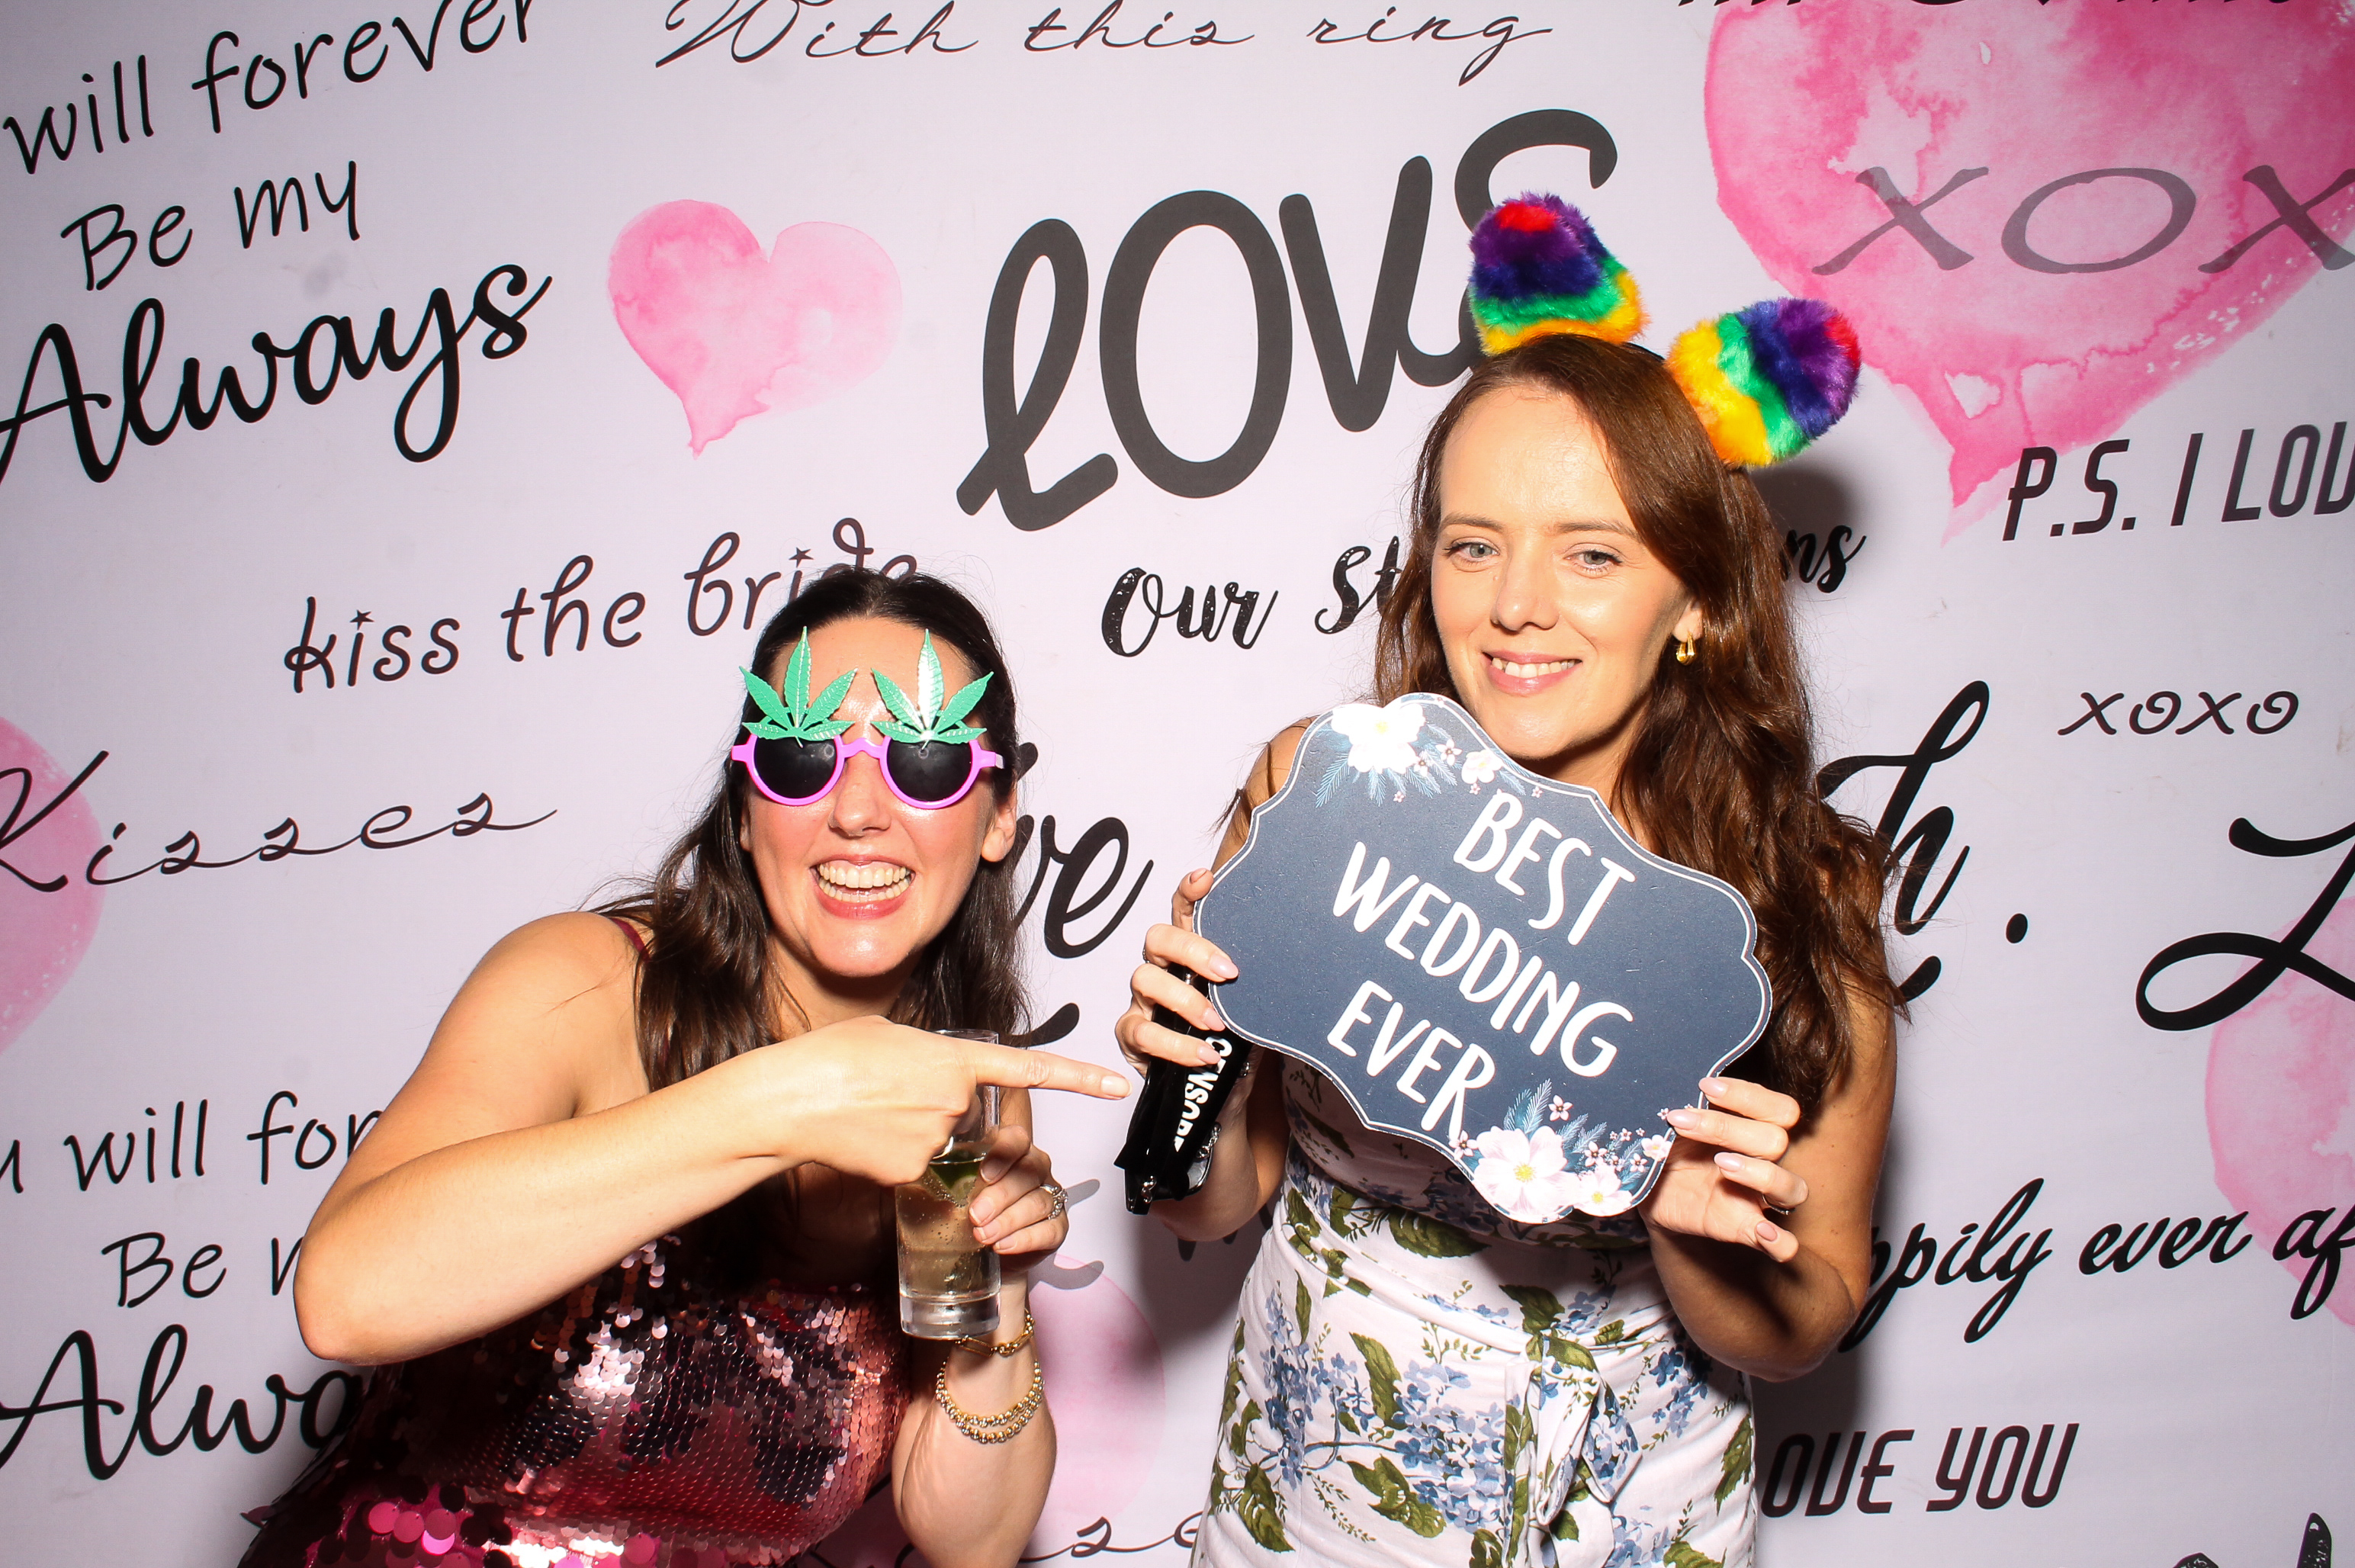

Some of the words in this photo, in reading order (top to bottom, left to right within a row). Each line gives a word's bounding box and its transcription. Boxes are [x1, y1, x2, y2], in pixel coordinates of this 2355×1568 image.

[1024, 0, 1254, 50] this
[1306, 6, 1553, 86] ring
[2, 55, 154, 175] will
[60, 204, 193, 291] Be
[233, 160, 360, 249] my
[0, 264, 553, 483] Always
[2002, 439, 2136, 541] P.S.
[2170, 432, 2204, 527] I
[2221, 421, 2355, 523] LOV
[284, 596, 460, 694] kiss
[500, 554, 646, 662] the
[1101, 567, 1279, 657] Our
[1454, 789, 1636, 946] BEST
[1332, 840, 1634, 1077] WEDDING
[1326, 980, 1496, 1142] EVER
[63, 1099, 208, 1191] will
[101, 1232, 227, 1309] Be
[2078, 1210, 2254, 1275] ever
[1760, 1428, 1915, 1518] OVE
[1926, 1423, 2080, 1512] YOU
